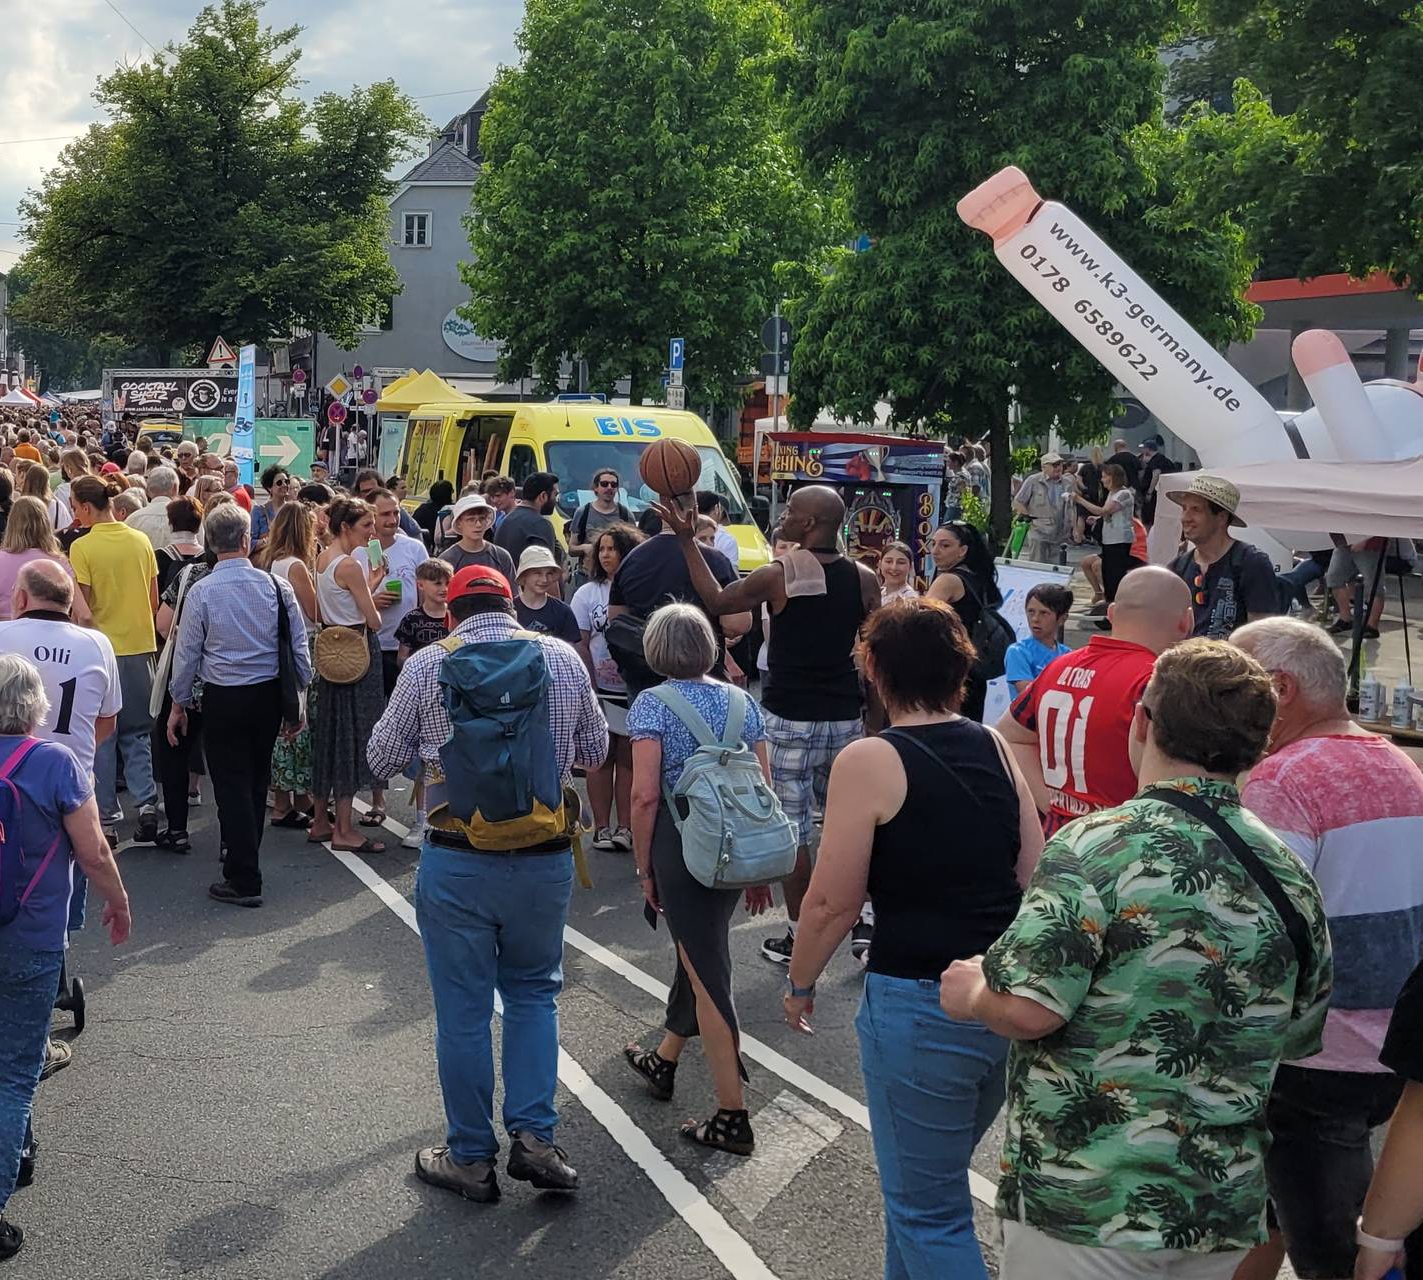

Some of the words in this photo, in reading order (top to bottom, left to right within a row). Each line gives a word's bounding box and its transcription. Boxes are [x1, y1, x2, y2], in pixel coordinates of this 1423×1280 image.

[1020, 244, 1071, 293] 0178
[1074, 299, 1159, 382] 6589622
[1049, 222, 1241, 412] www.k3-germany.de
[673, 342, 681, 366] P
[120, 381, 179, 392] COCKTAIL
[593, 416, 662, 437] EIS
[914, 493, 934, 591] BOXIN
[33, 645, 71, 665] Olli
[1057, 666, 1096, 688] ULTRAS
[51, 676, 77, 735] 1
[1038, 690, 1093, 793] 01
